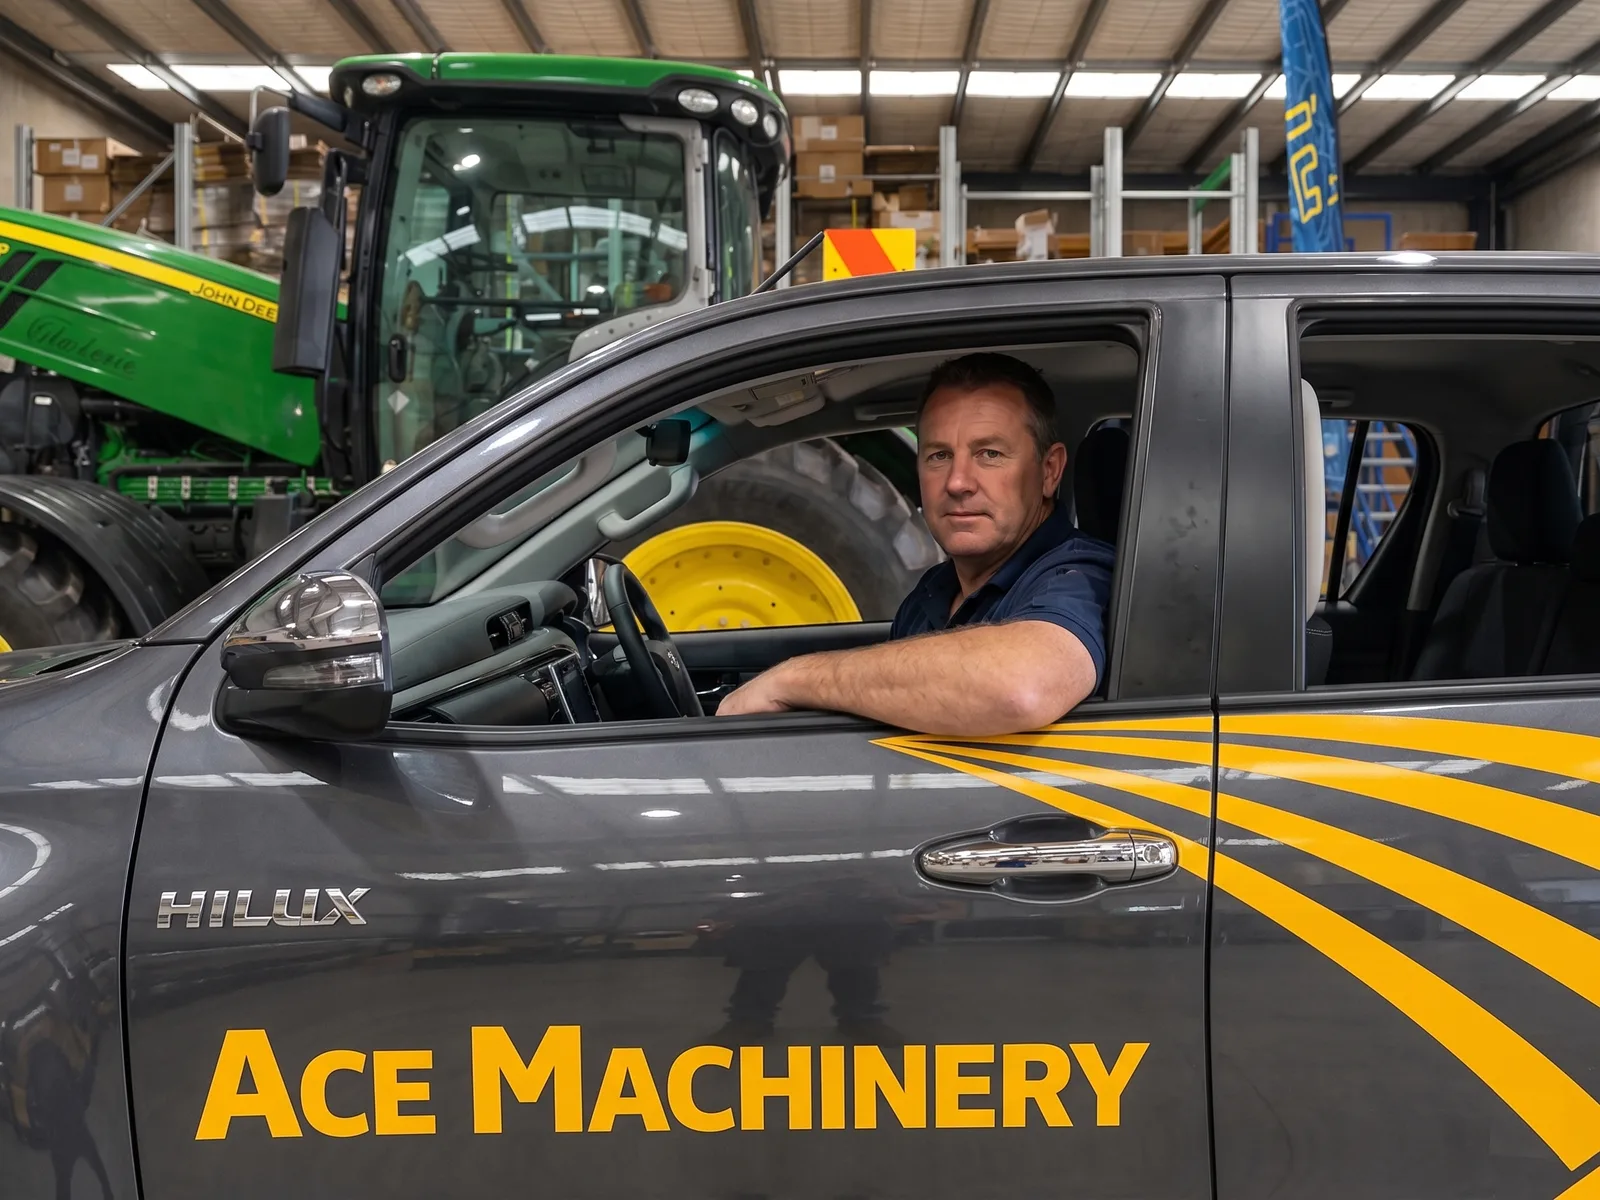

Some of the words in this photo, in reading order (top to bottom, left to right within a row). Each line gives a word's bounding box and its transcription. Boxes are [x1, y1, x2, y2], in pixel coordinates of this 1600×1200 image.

[192, 282, 240, 307] JOHN
[155, 886, 372, 930] HILUX
[195, 1029, 437, 1141] ACE
[470, 1025, 1151, 1135] MACHINERY
